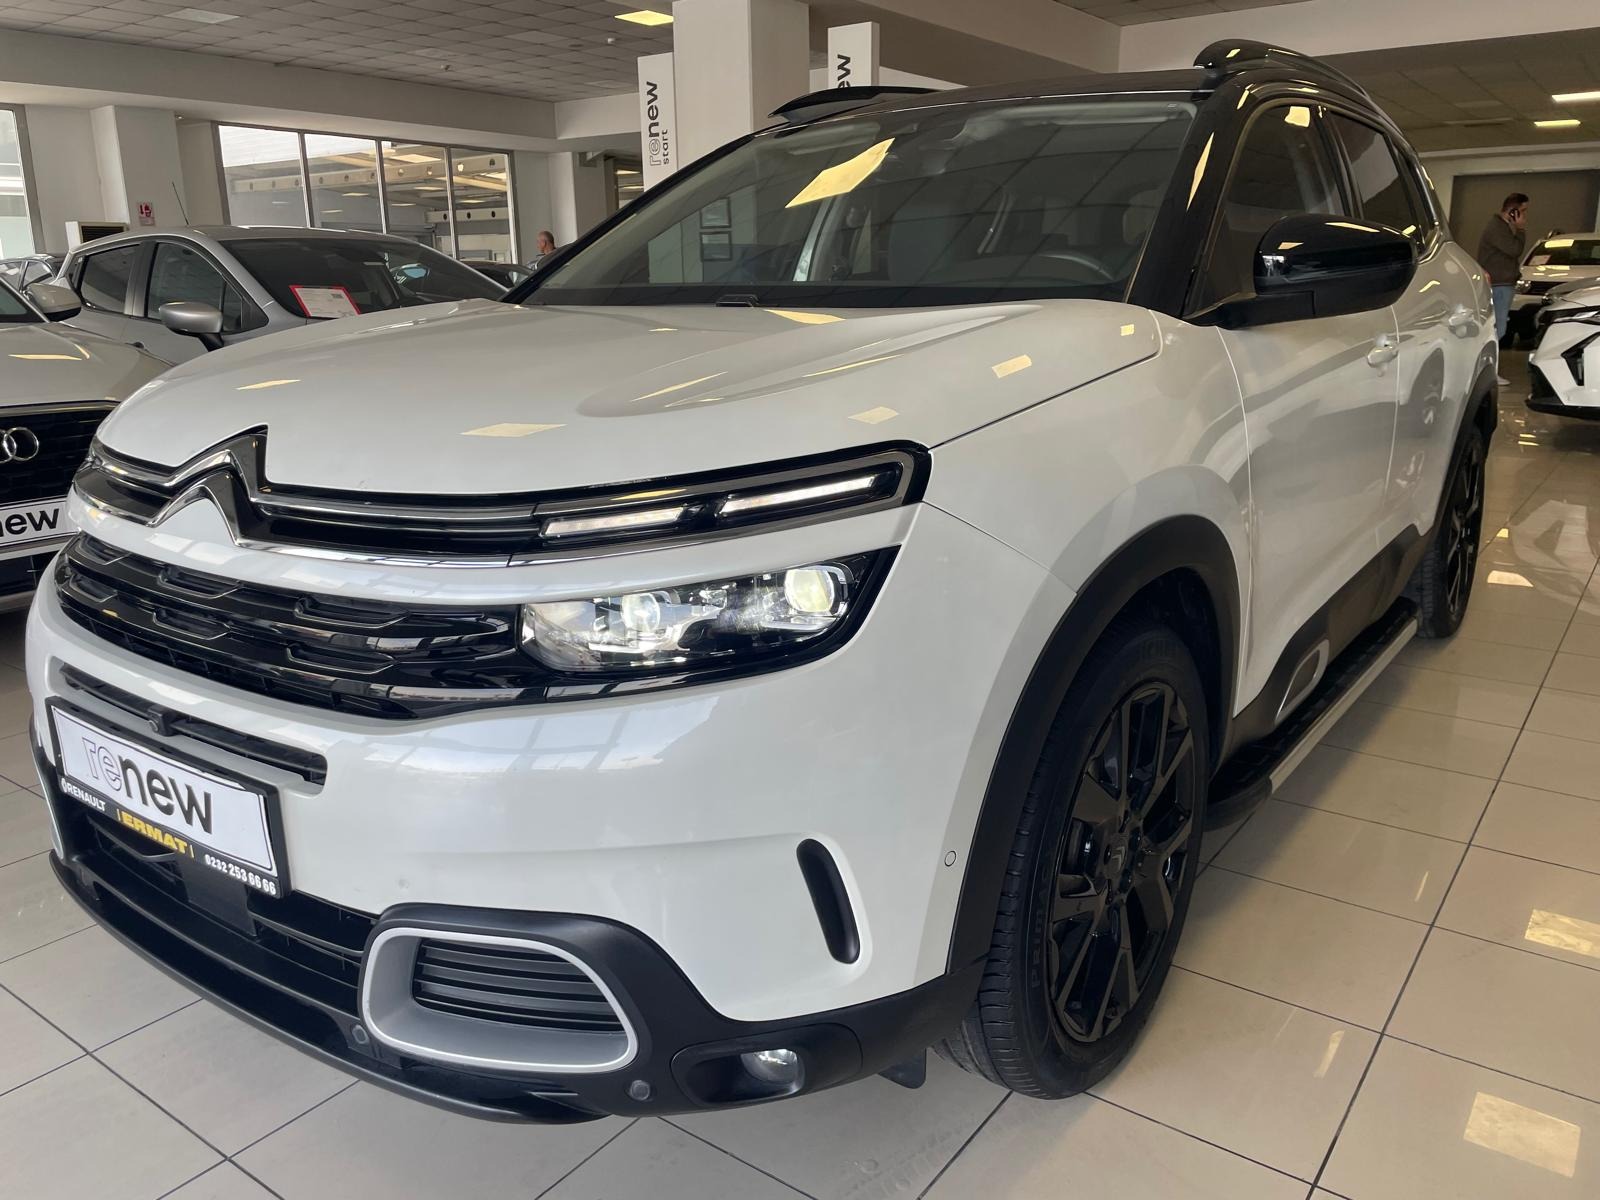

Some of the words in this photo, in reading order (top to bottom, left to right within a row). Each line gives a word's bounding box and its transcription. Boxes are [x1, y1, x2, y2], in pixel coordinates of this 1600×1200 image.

[646, 81, 661, 166] renew
[662, 129, 670, 165] start
[0, 508, 60, 537] ew
[66, 782, 106, 811] RENAULT
[82, 737, 213, 835] renew
[120, 811, 188, 854] ERMAT
[205, 854, 228, 873] 0232
[228, 863, 247, 882] 253
[248, 872, 262, 889] 66
[262, 878, 277, 895] 66
